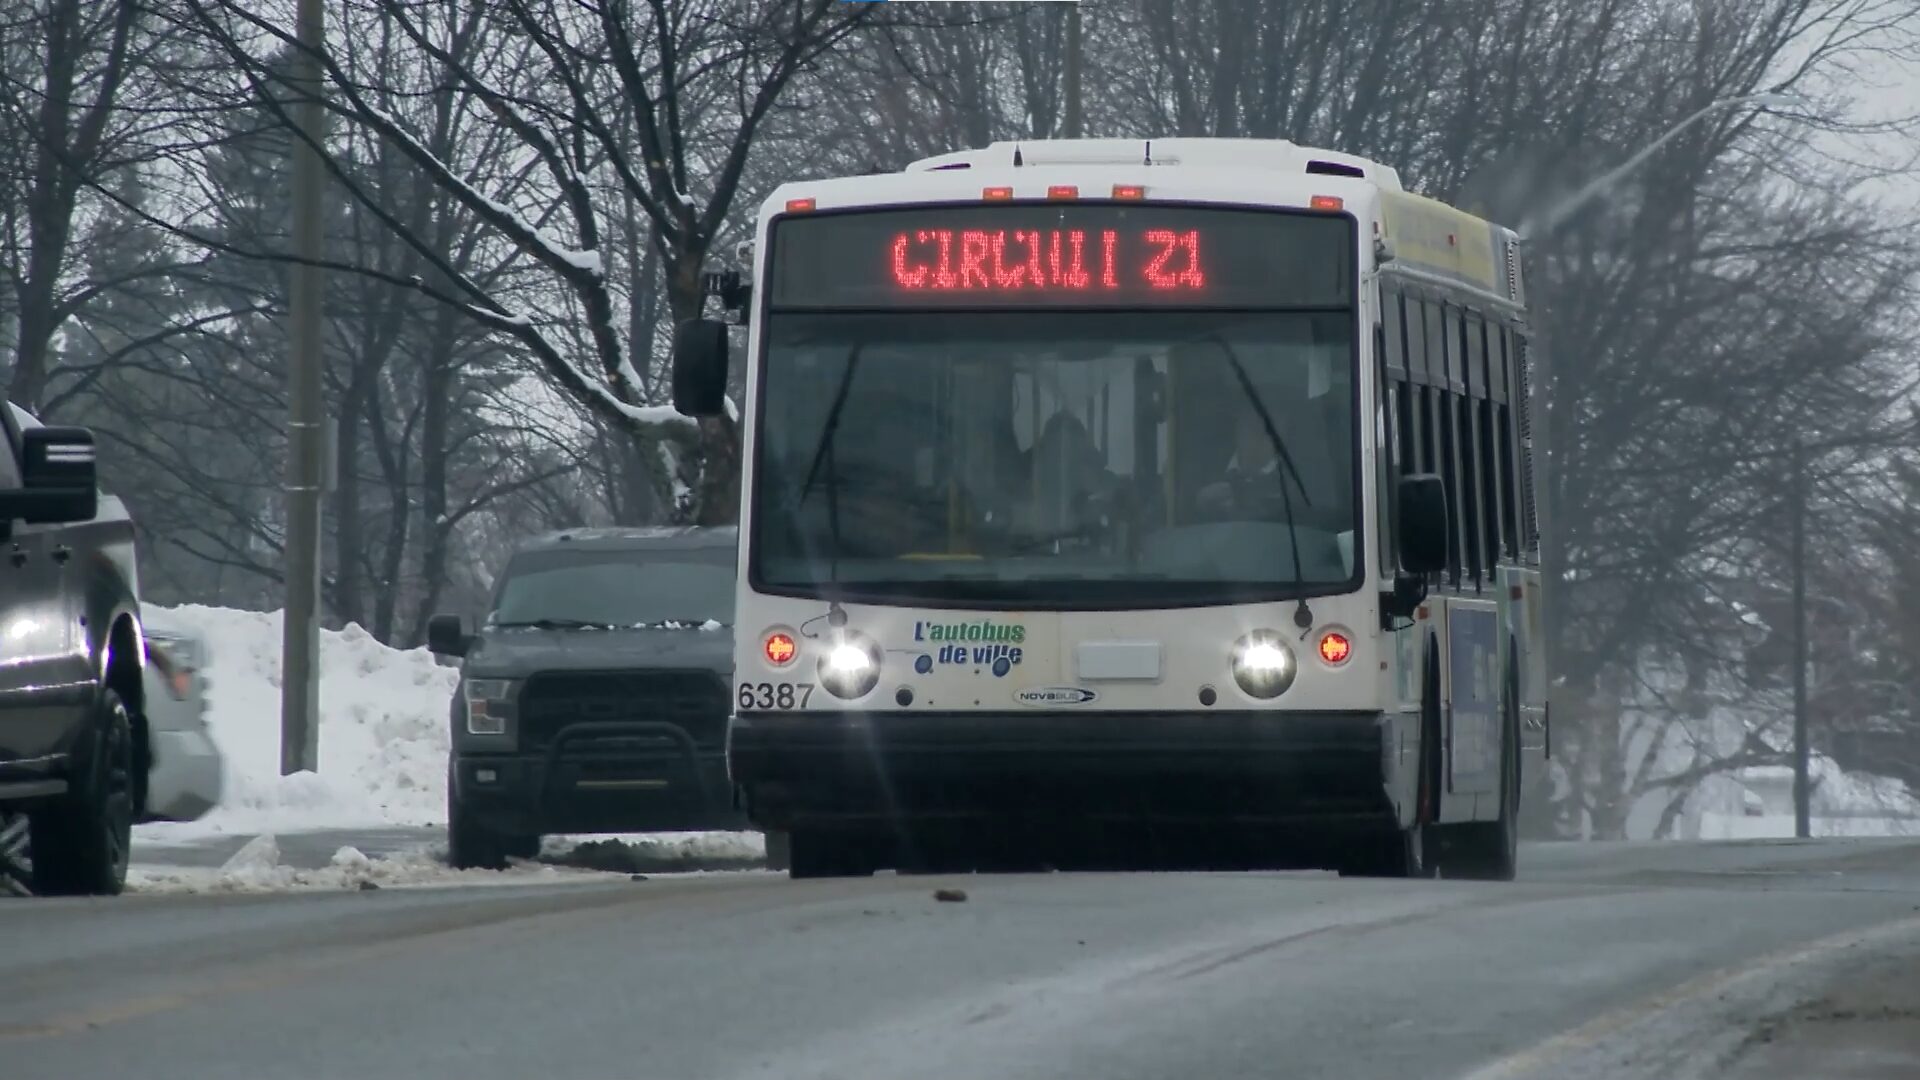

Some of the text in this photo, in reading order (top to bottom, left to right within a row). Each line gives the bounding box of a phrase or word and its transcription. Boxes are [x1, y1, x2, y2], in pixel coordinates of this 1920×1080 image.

[1143, 231, 1204, 288] 21
[914, 621, 1025, 643] L'autobus
[938, 644, 1022, 664] de ville
[738, 682, 815, 710] 6387
